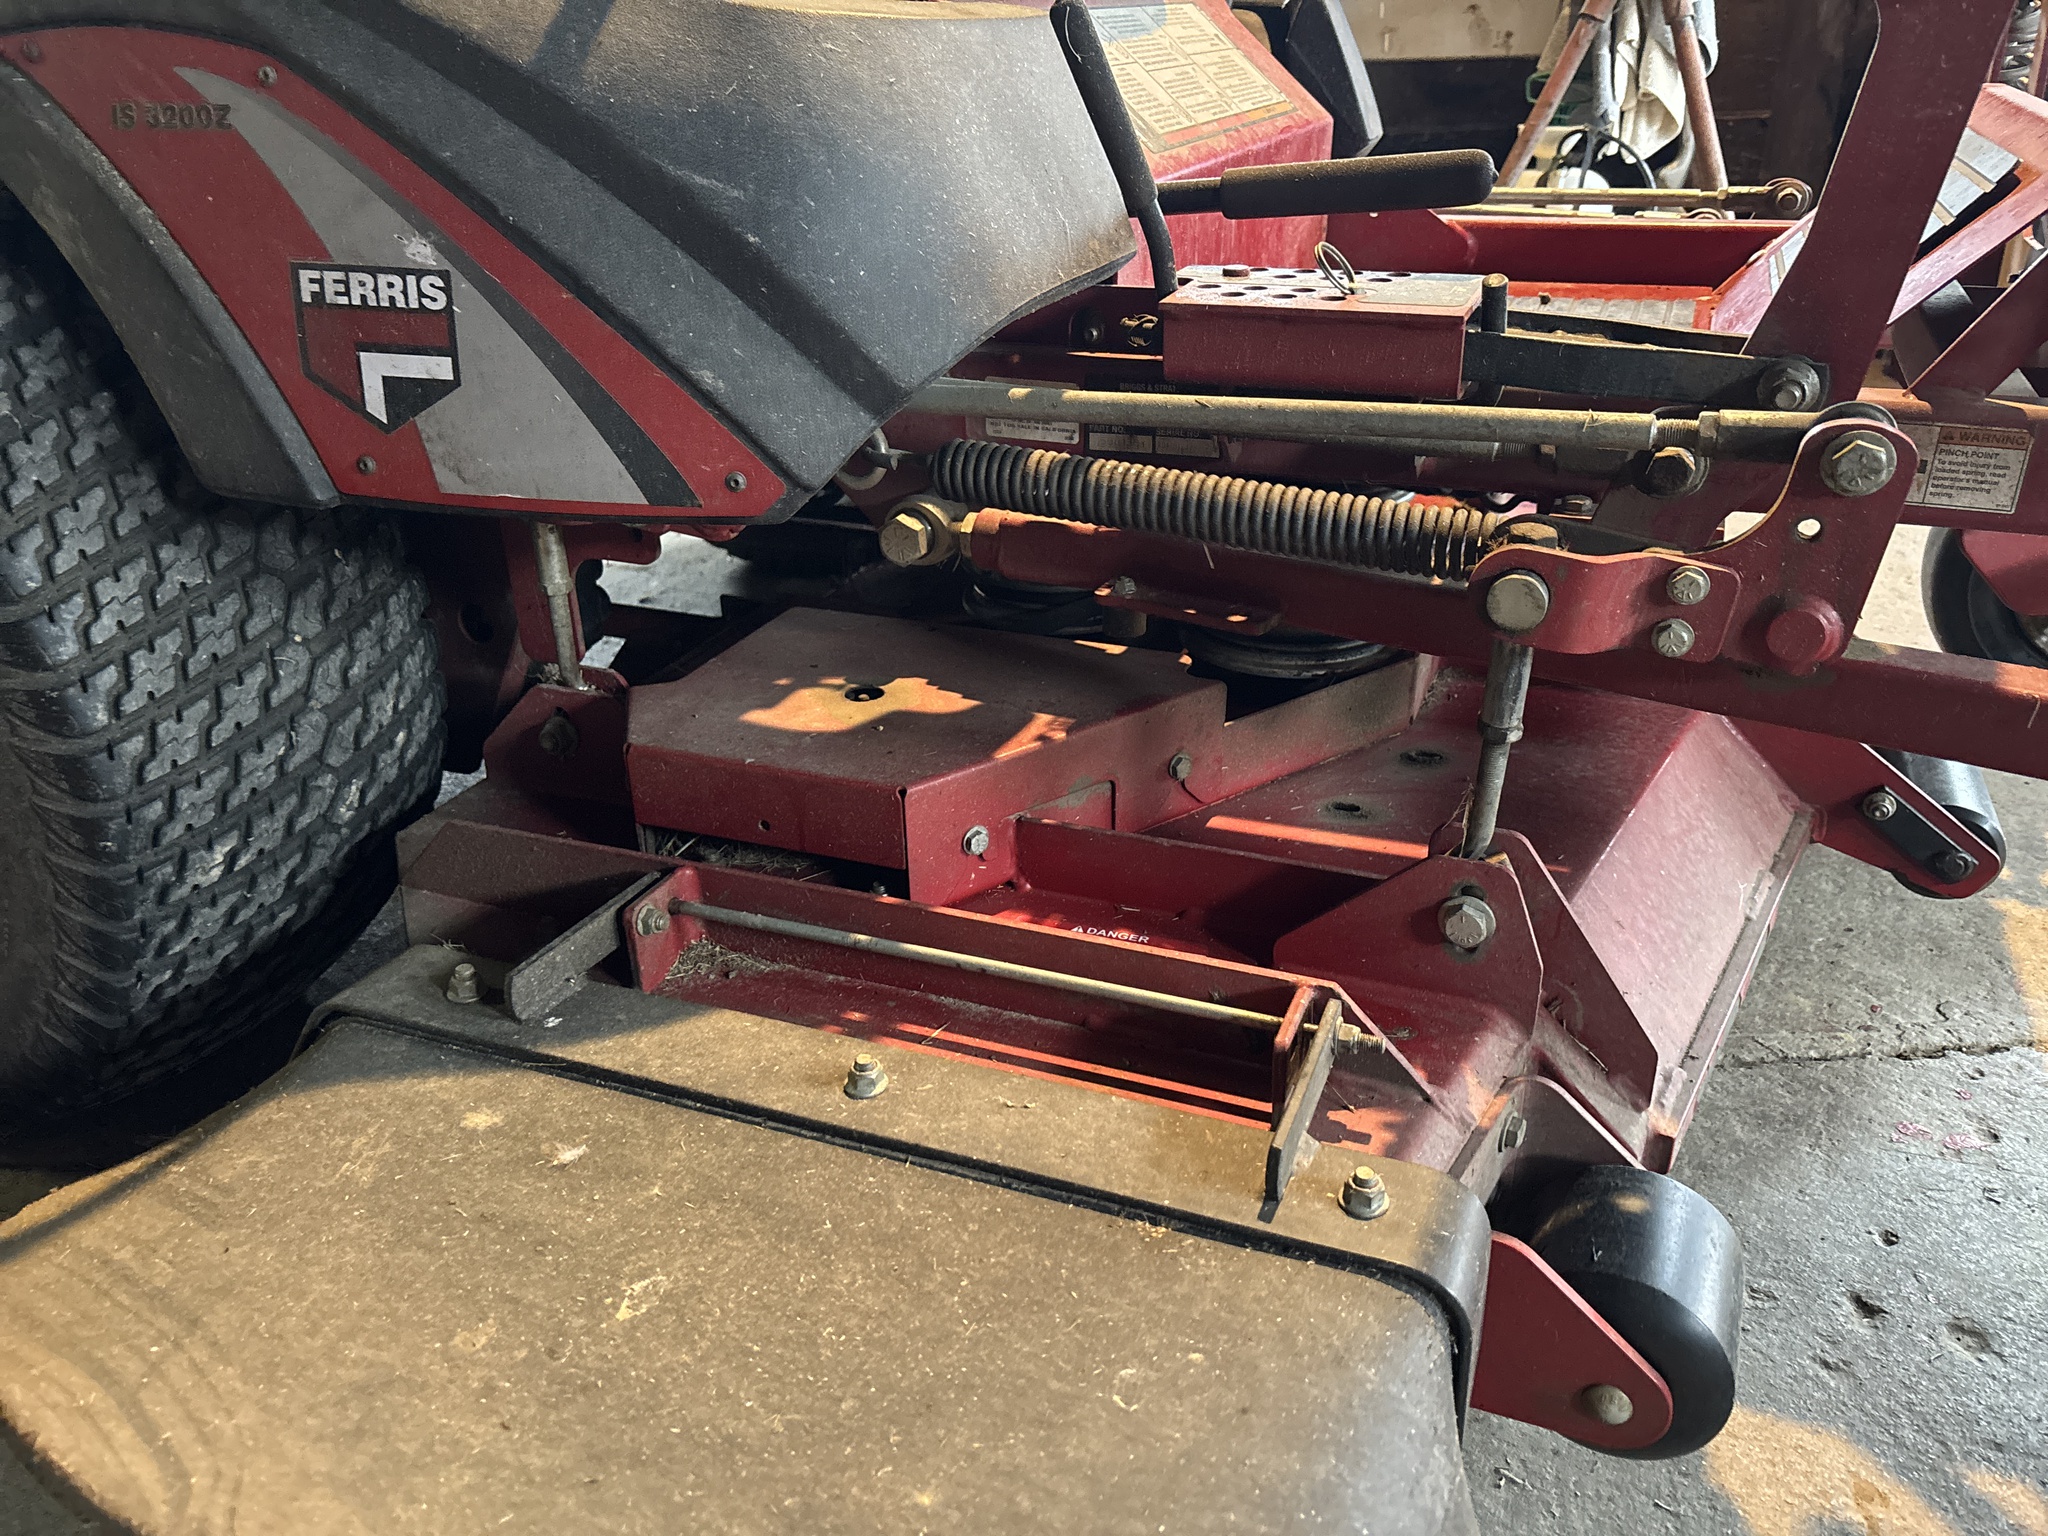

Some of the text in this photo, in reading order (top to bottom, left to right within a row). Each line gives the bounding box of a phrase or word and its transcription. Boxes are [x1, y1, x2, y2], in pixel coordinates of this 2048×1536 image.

[111, 101, 136, 129] IS
[298, 269, 448, 311] FERRIS
[1119, 383, 1146, 391] BRIGGS
[1959, 431, 2026, 446] WARNING
[1938, 448, 2000, 460] PINCH POINT
[1970, 461, 1992, 470] injury
[1993, 463, 2011, 471] from
[1935, 466, 1960, 474] loaded
[1989, 471, 2007, 479] read
[1932, 475, 2000, 486] operator's manual
[1930, 482, 1992, 494] before removing
[1928, 491, 1955, 499] spring.
[1087, 928, 1150, 943] DANGER
